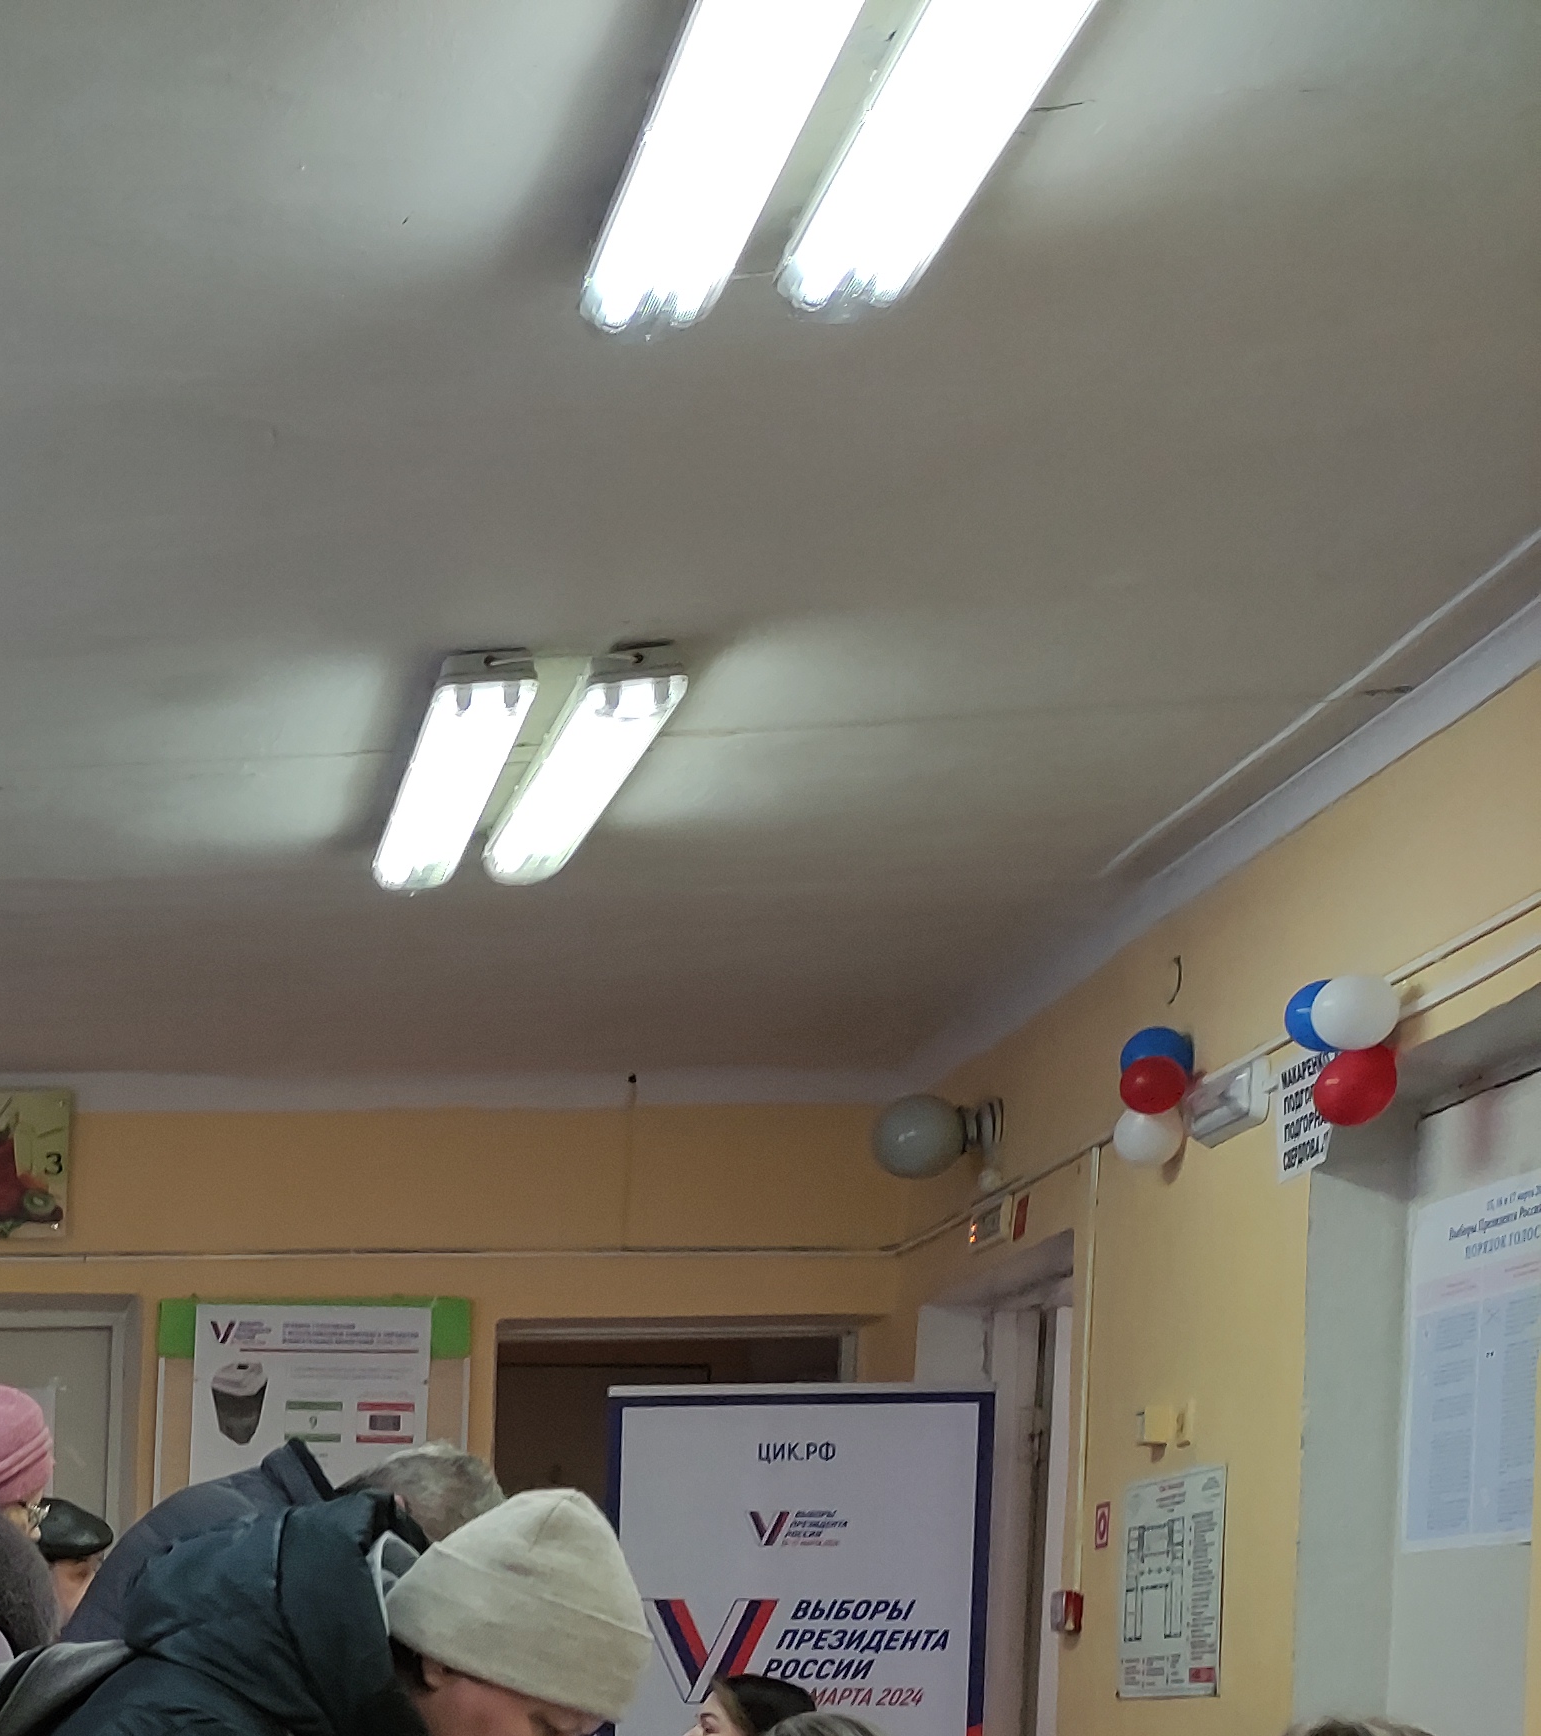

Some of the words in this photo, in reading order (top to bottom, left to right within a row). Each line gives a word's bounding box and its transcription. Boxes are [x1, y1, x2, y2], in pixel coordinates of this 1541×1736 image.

[44, 1152, 63, 1175] 3
[757, 1440, 837, 1464] ЦИК.РФ
[789, 1597, 917, 1621] ВЫБОРЫ
[774, 1628, 951, 1655] ПРЕЗИДЕНТА
[761, 1658, 876, 1681] РОССИИ
[875, 1687, 925, 1707] 2024
